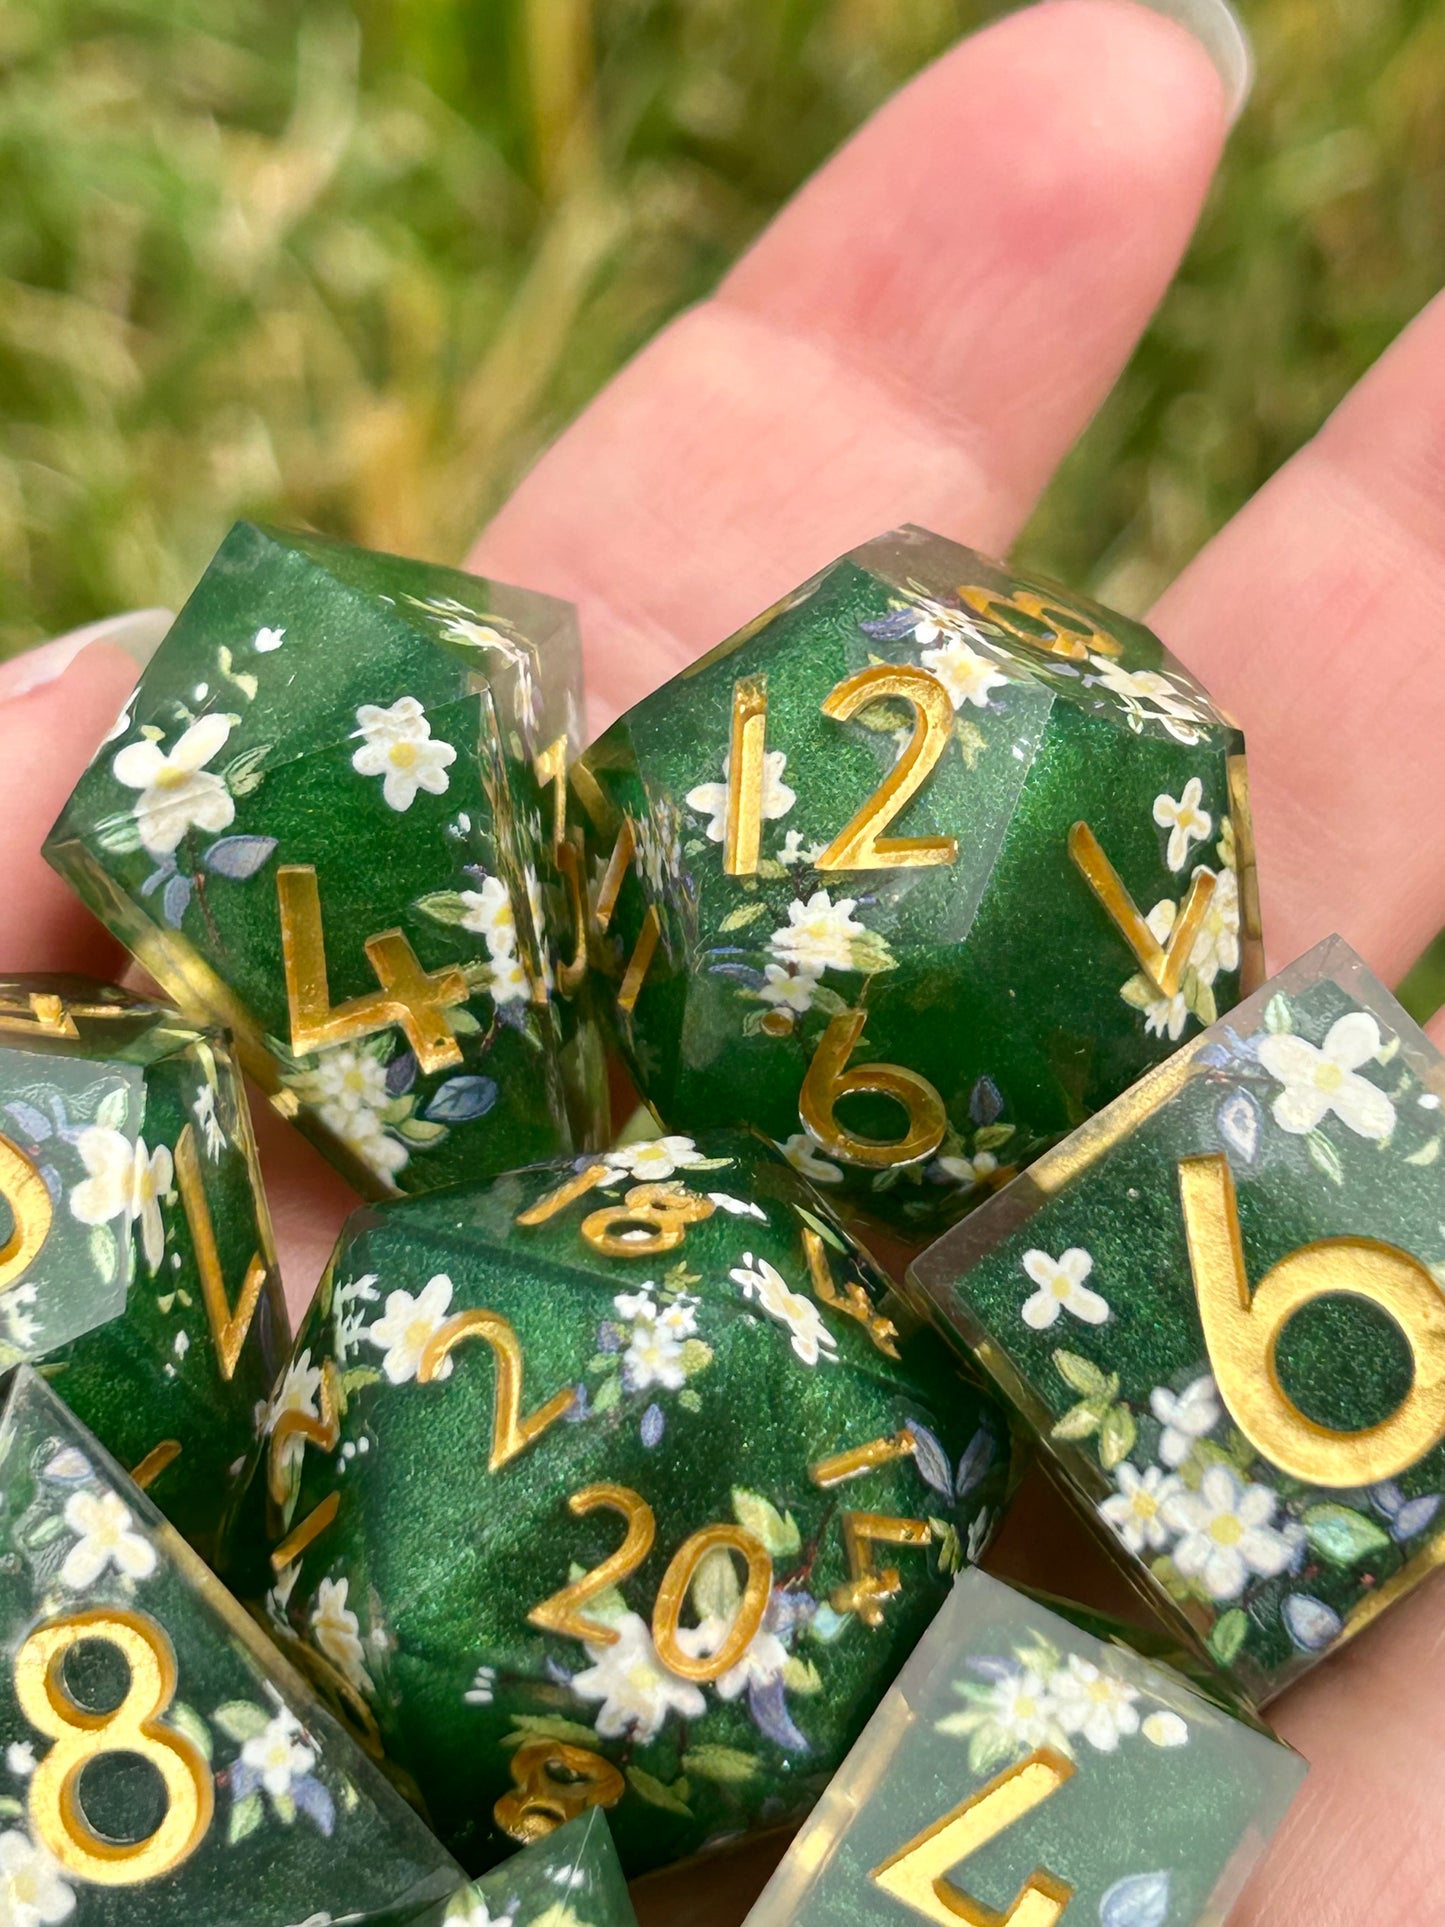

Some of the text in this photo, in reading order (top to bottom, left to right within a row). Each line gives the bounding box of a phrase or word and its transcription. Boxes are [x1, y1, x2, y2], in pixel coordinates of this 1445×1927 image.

[723, 664, 959, 876] 12
[277, 864, 470, 1075] 4
[516, 1164, 716, 1257] 18
[418, 1308, 577, 1473] 2
[1179, 1154, 1445, 1488] 6
[528, 1484, 773, 1682] 20
[14, 1608, 214, 1886] 8
[493, 1738, 626, 1845] 8
